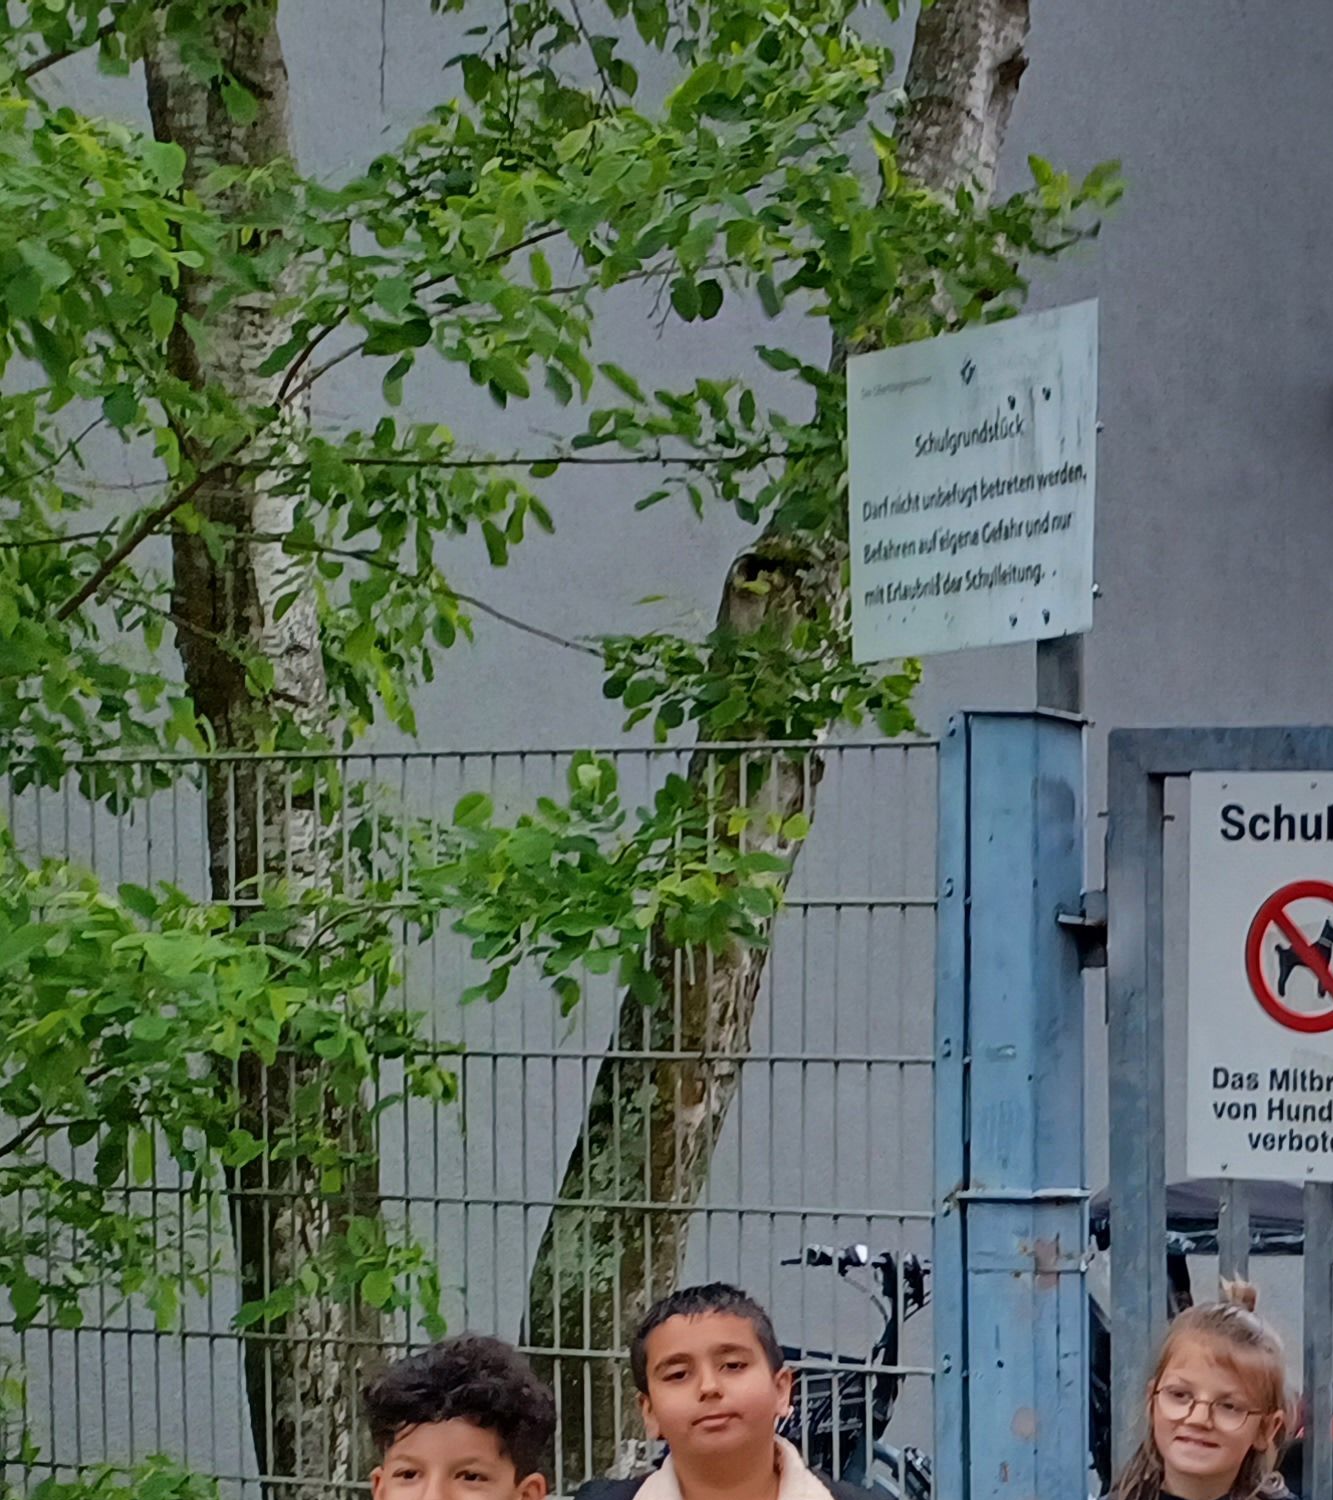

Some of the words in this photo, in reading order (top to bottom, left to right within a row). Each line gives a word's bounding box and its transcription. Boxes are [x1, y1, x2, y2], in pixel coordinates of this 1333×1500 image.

[915, 412, 1025, 457] Schulgrundstück
[863, 496, 888, 522] Darf
[890, 490, 919, 515] nicht
[922, 482, 978, 511] unbefugt
[980, 474, 1035, 501] betreten
[863, 540, 916, 565] Befahren
[919, 529, 937, 555] auf
[940, 529, 979, 556] eigene
[982, 518, 1023, 544] Gefahr
[1025, 510, 1050, 538] und
[1052, 512, 1072, 533] nur
[864, 584, 884, 607] mit
[943, 571, 964, 596] der
[1212, 1067, 1259, 1091] Das
[1212, 1101, 1257, 1121] von
